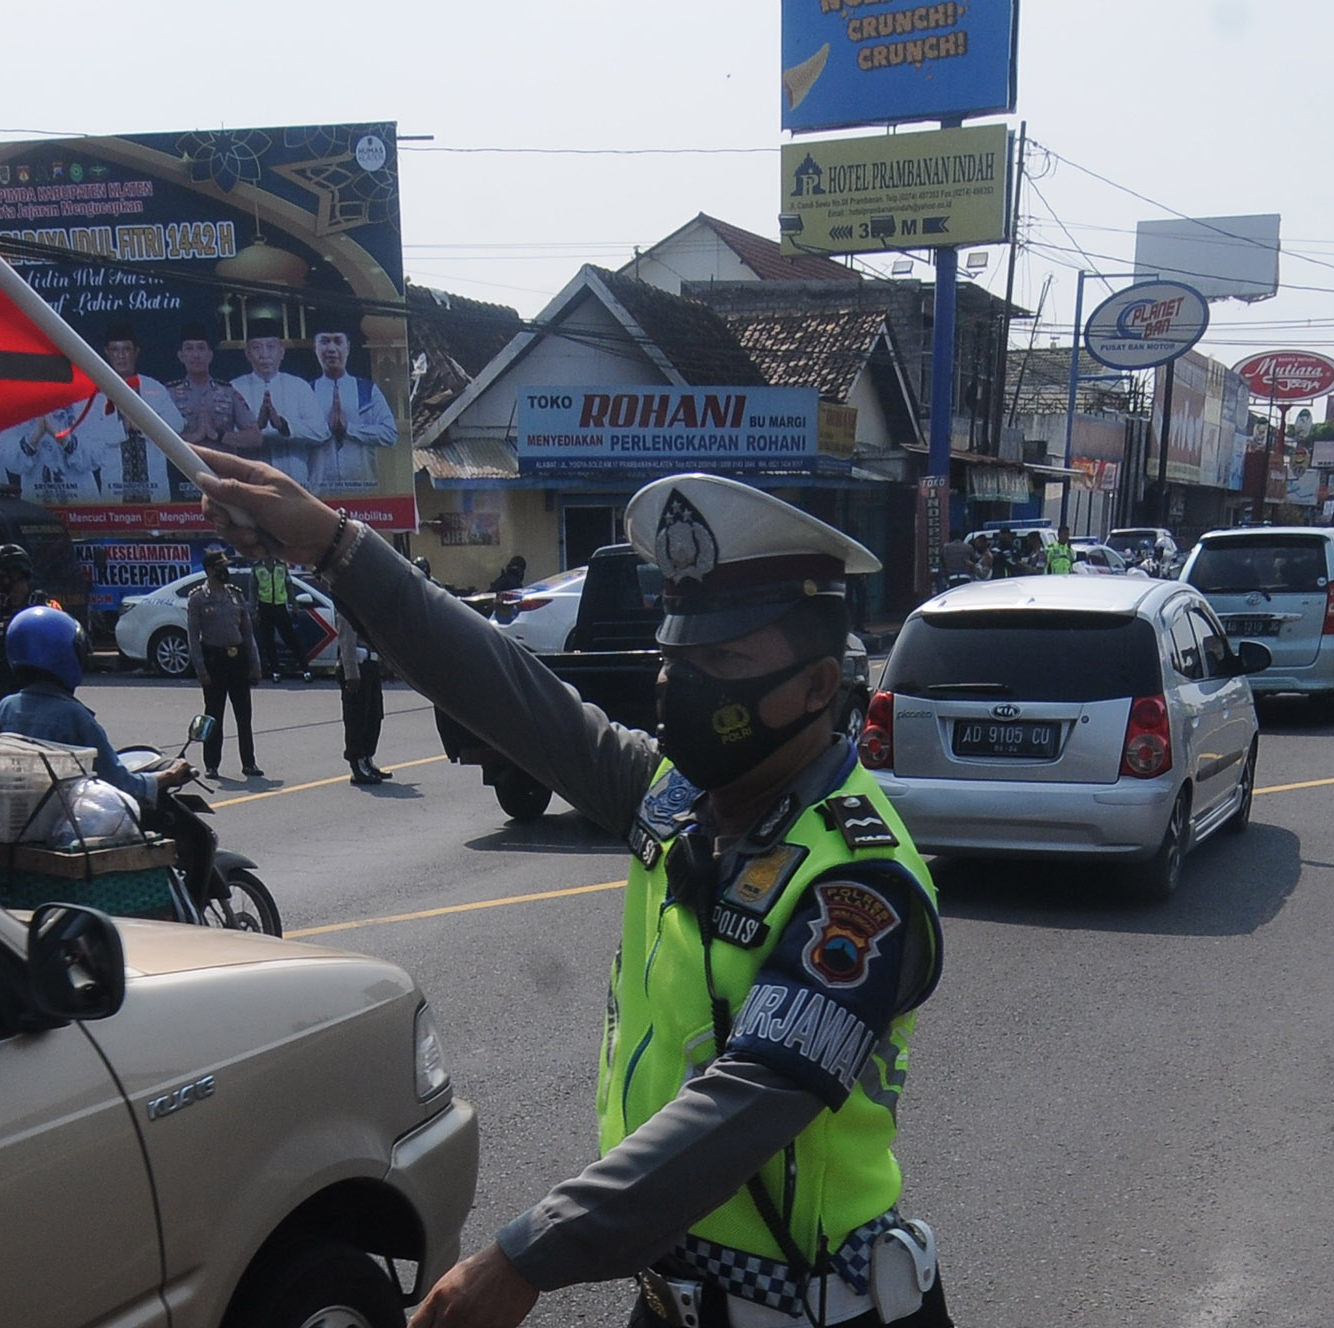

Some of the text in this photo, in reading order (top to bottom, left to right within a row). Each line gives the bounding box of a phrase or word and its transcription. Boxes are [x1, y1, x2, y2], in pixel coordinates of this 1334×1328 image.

[847, 2, 957, 41] CRUNCH!
[857, 32, 967, 70] CRUNCH!
[828, 152, 995, 194] HOTEL PRAMBANAN INDAH
[37, 184, 106, 201] KABUPATEN
[108, 181, 153, 197] KLATEN
[18, 202, 59, 219] Jajaran
[61, 200, 144, 218] Mengucapkan
[901, 220, 917, 235] M
[70, 226, 117, 259] IDUL
[116, 223, 165, 261] FITRI
[166, 222, 218, 260] 1442
[218, 221, 235, 258] H
[28, 270, 69, 289] idin
[72, 293, 123, 316] Lahir
[128, 292, 182, 311] Batin
[1132, 296, 1185, 327] PLANET
[1143, 318, 1171, 338] BAN
[1244, 358, 1323, 378] Mutiara
[527, 394, 806, 429] TOKO ROHANI BU MARGI
[527, 434, 806, 451] MENYEDIAKAN PERLENGKAPAN ROHANI
[69, 511, 393, 525] Mencuci Tangan Menghind Mobilitas
[104, 545, 190, 561] KESELAMATAN
[97, 564, 191, 586] KECEPATAN
[897, 710, 933, 720] picanto
[996, 706, 1018, 716] KIA
[721, 727, 753, 745] POLRI
[962, 726, 1050, 744] AD 9105 CU
[712, 905, 760, 944] POLISI
